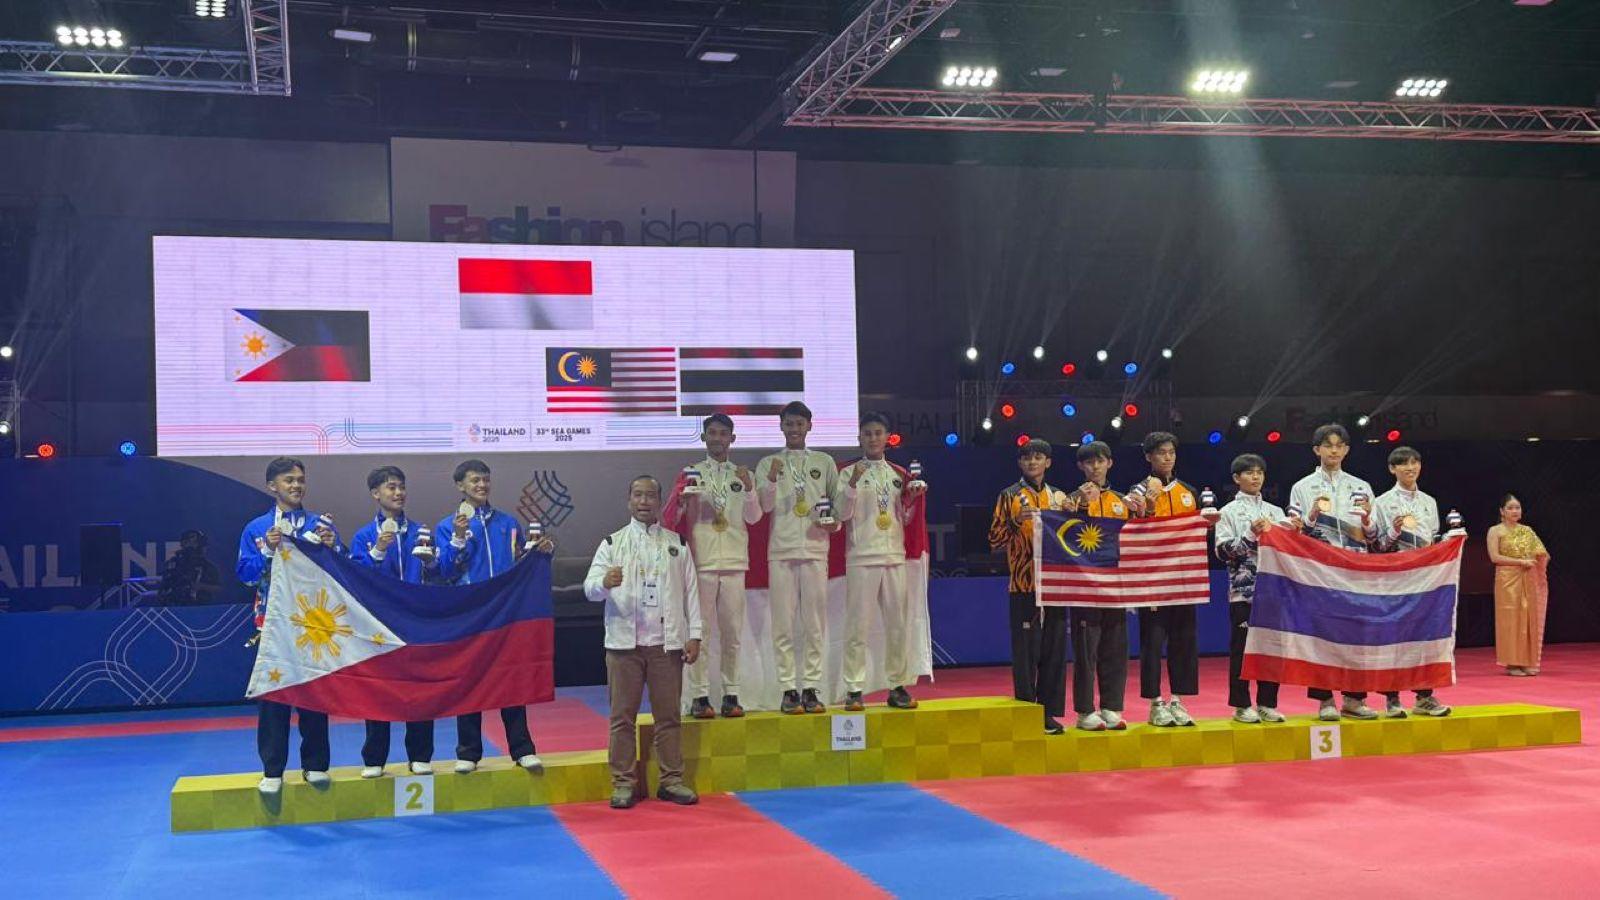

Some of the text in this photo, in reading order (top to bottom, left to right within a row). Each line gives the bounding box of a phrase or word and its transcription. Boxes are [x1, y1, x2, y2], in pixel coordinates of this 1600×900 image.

[429, 204, 762, 248] Fashion island
[482, 427, 526, 436] THAILAND
[1319, 730, 1333, 753] 3
[405, 782, 424, 810] 2
